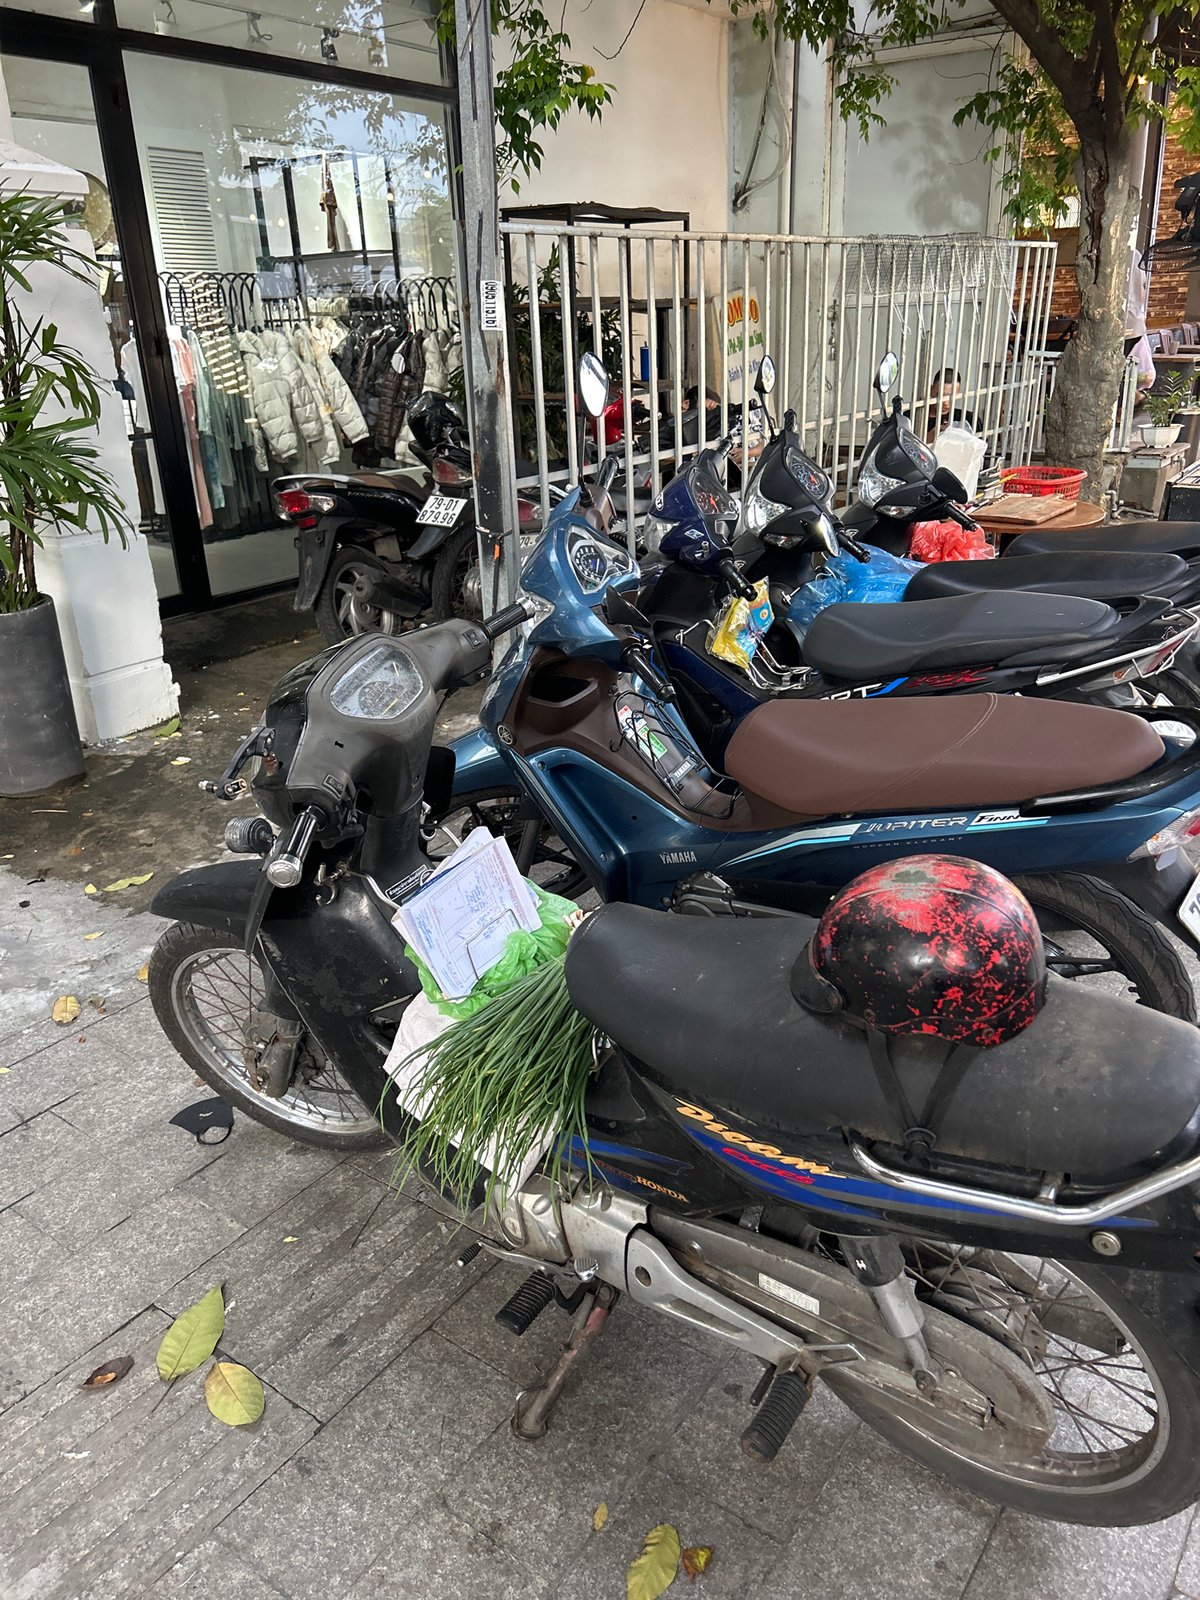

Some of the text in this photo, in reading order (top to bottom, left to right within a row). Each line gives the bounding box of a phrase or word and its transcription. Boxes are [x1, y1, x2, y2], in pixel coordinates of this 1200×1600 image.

[430, 497, 459, 511] 79-D1
[419, 510, 456, 525] 879.96
[659, 851, 697, 864] YAMAHA
[672, 1095, 848, 1179] Dream
[635, 1175, 690, 1204] HONDA
